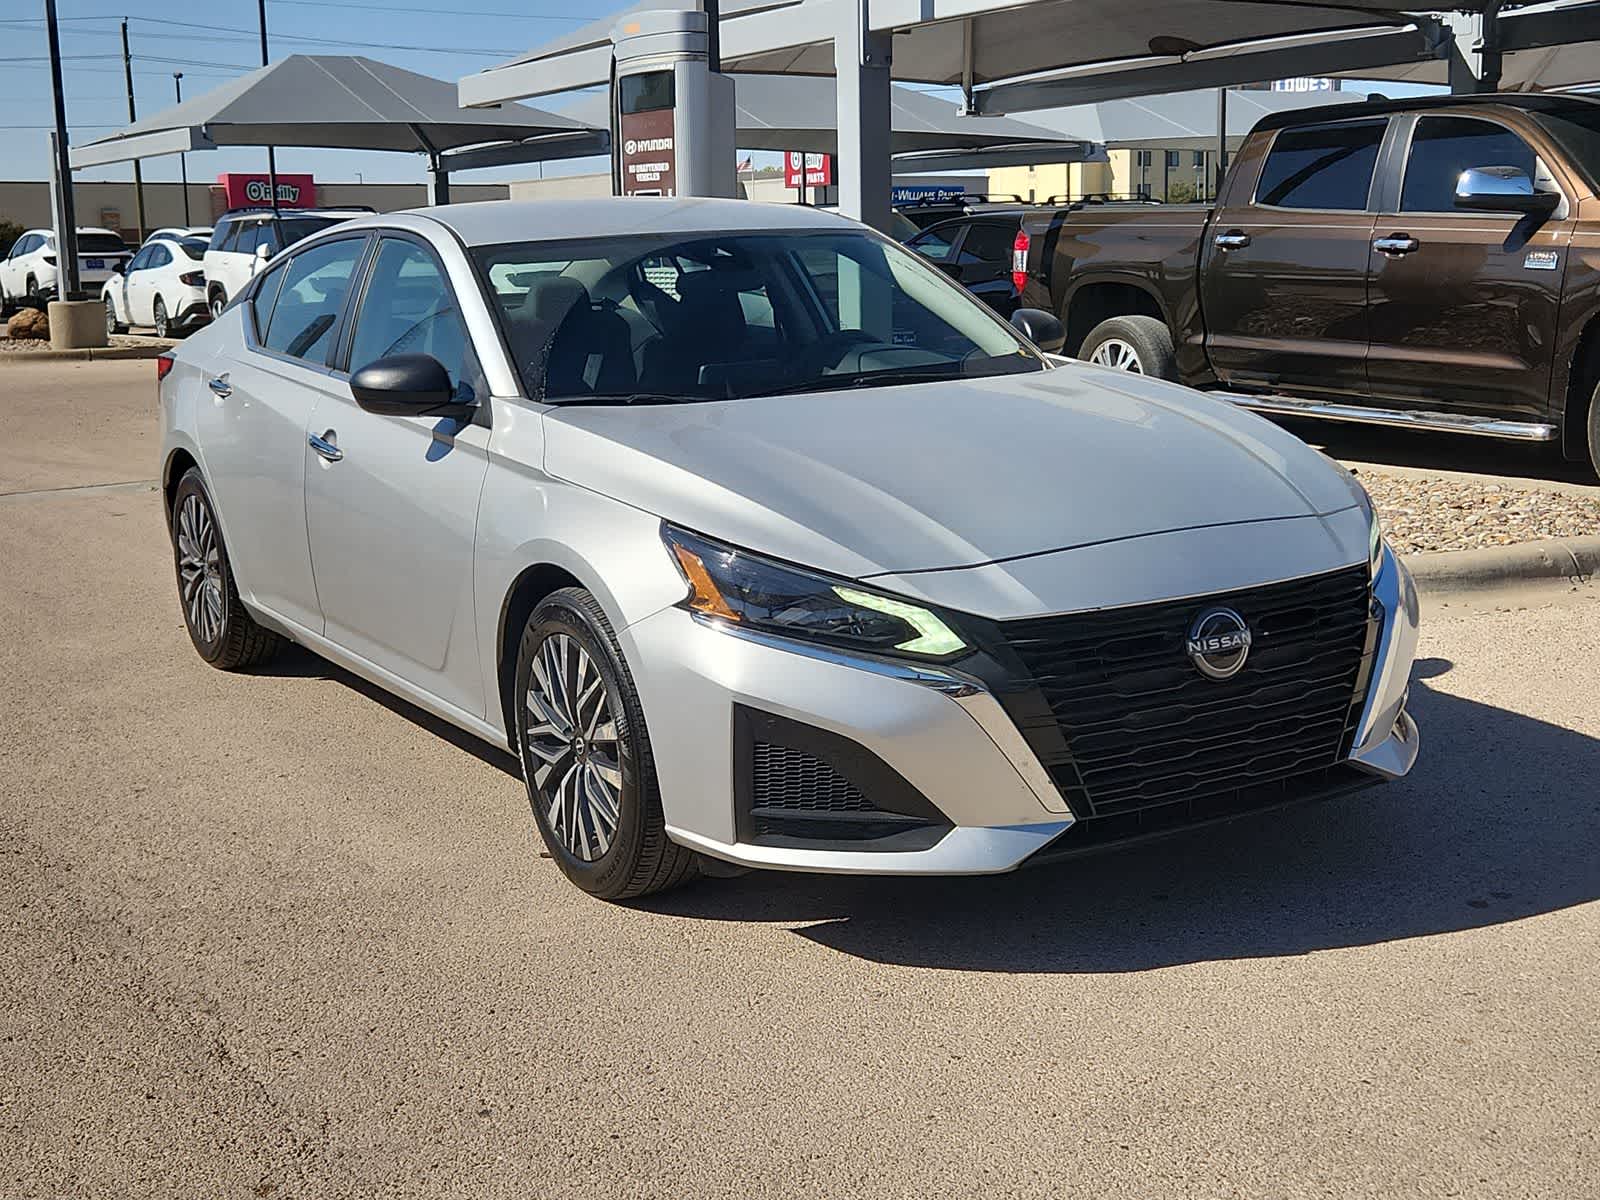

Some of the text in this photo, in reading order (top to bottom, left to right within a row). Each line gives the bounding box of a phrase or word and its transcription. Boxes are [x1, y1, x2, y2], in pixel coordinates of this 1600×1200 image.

[637, 138, 673, 152] HYUNDAI
[246, 182, 299, 203] O'Rilly
[1188, 632, 1250, 652] NISSAN
